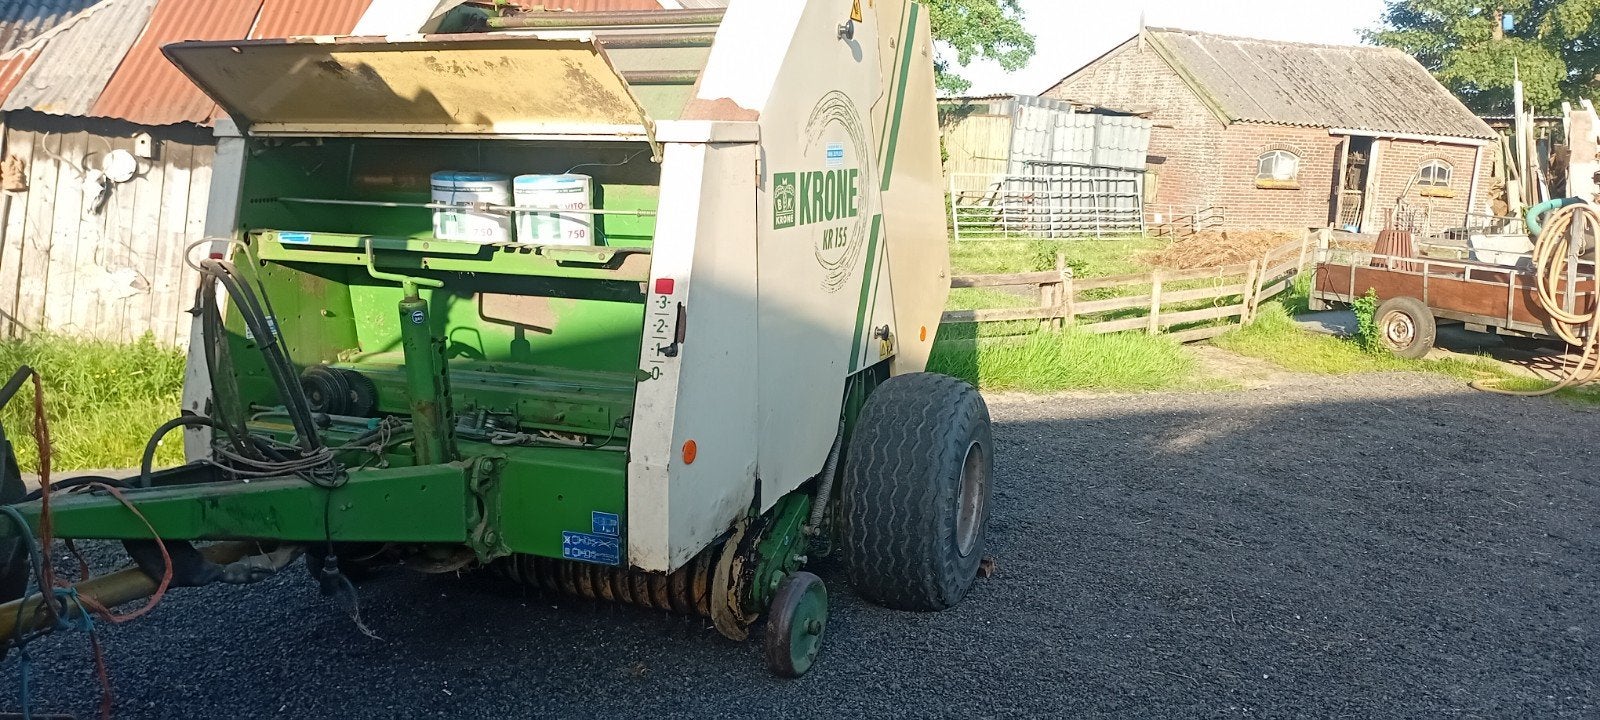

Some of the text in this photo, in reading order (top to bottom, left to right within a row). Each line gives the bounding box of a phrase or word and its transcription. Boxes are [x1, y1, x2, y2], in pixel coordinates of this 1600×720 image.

[799, 168, 858, 226] KRONE
[775, 214, 794, 225] KRONE
[473, 227, 493, 237] 750
[568, 229, 585, 239] 750
[823, 226, 848, 251] KR 155
